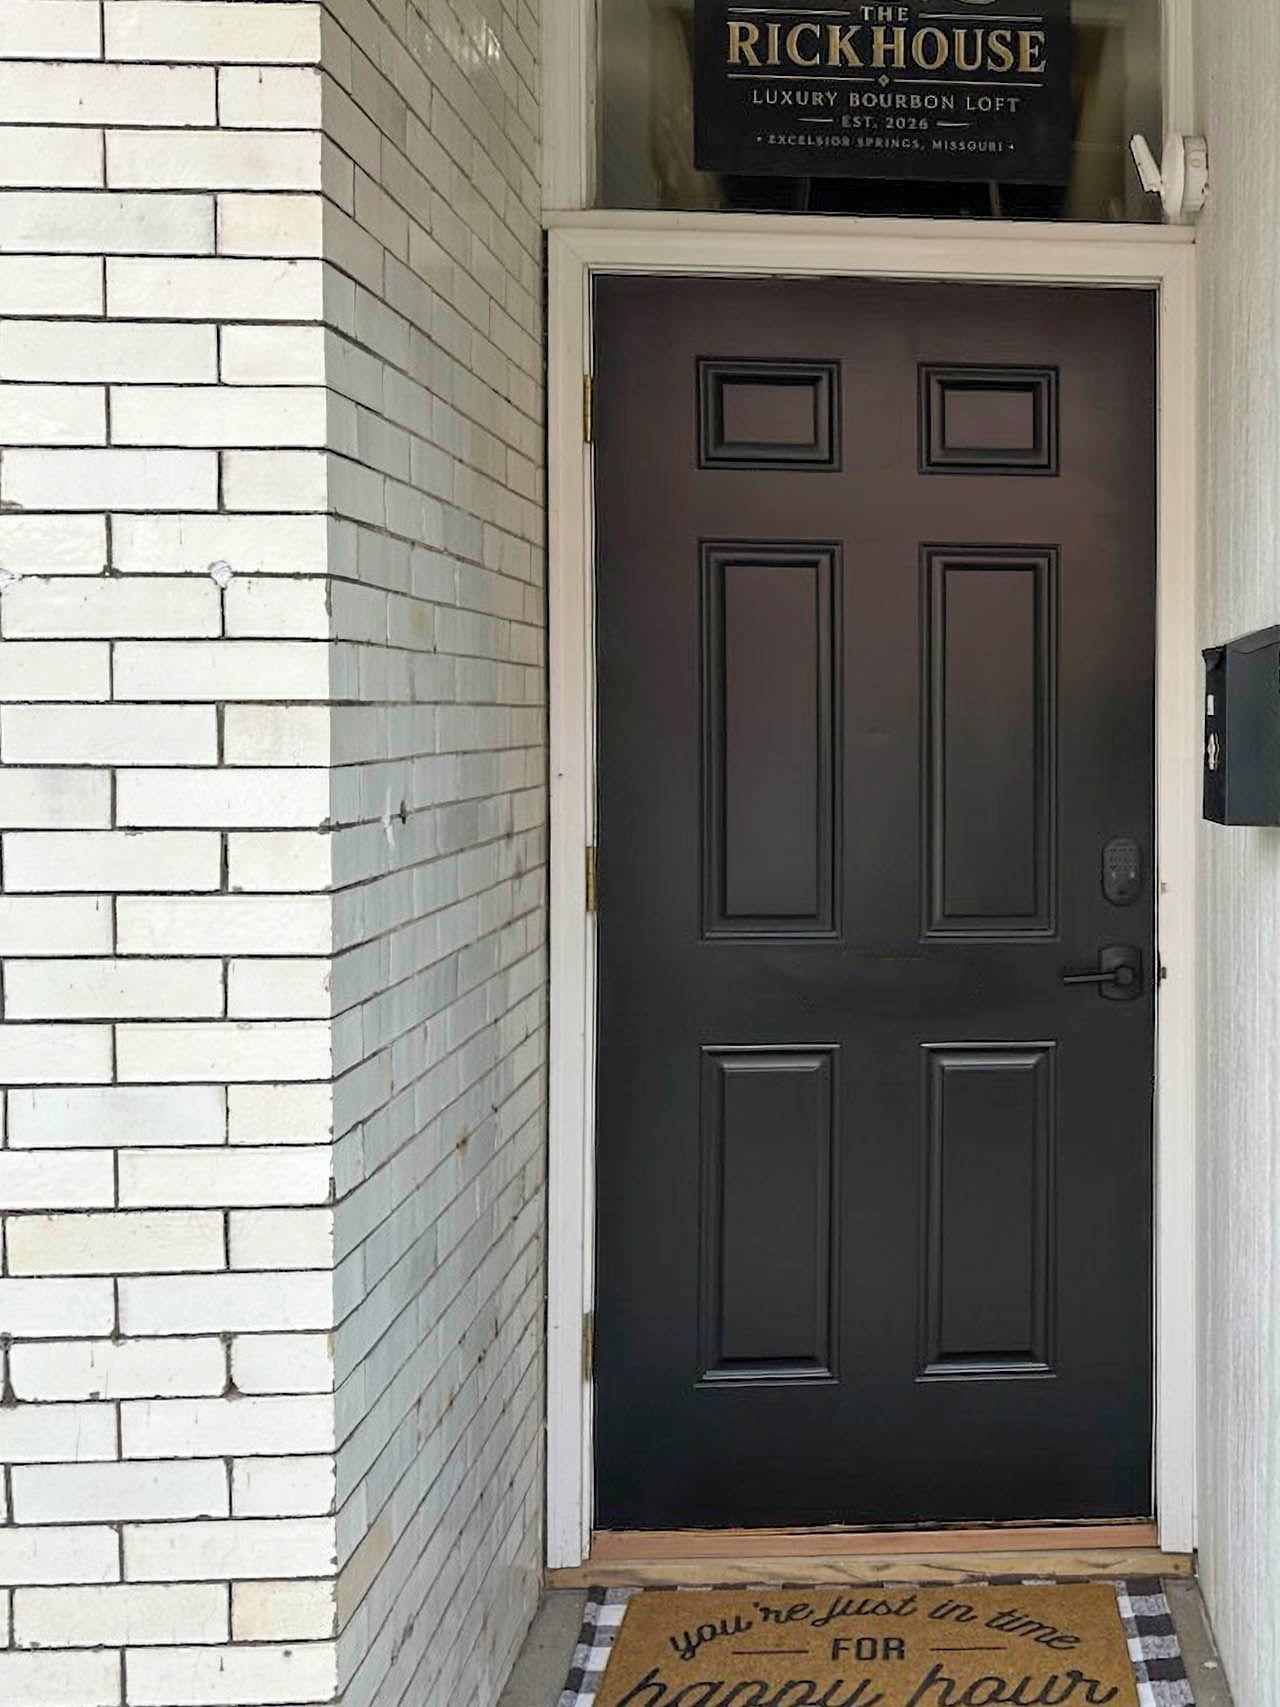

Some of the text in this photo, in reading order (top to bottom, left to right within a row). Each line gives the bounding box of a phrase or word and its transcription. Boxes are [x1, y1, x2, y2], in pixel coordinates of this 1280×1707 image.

[859, 6, 909, 22] THE
[726, 21, 1048, 74] RICKHOUSE
[752, 88, 1021, 113] LUXURY BOURBON LOFT
[841, 115, 929, 130] EST. 2026
[767, 134, 1003, 152] EXCELSIOR SPRINGS, MISSOURI
[669, 1594, 1081, 1661] you're just in time
[831, 1637, 905, 1661] FOR
[904, 1662, 1119, 1707] hour
